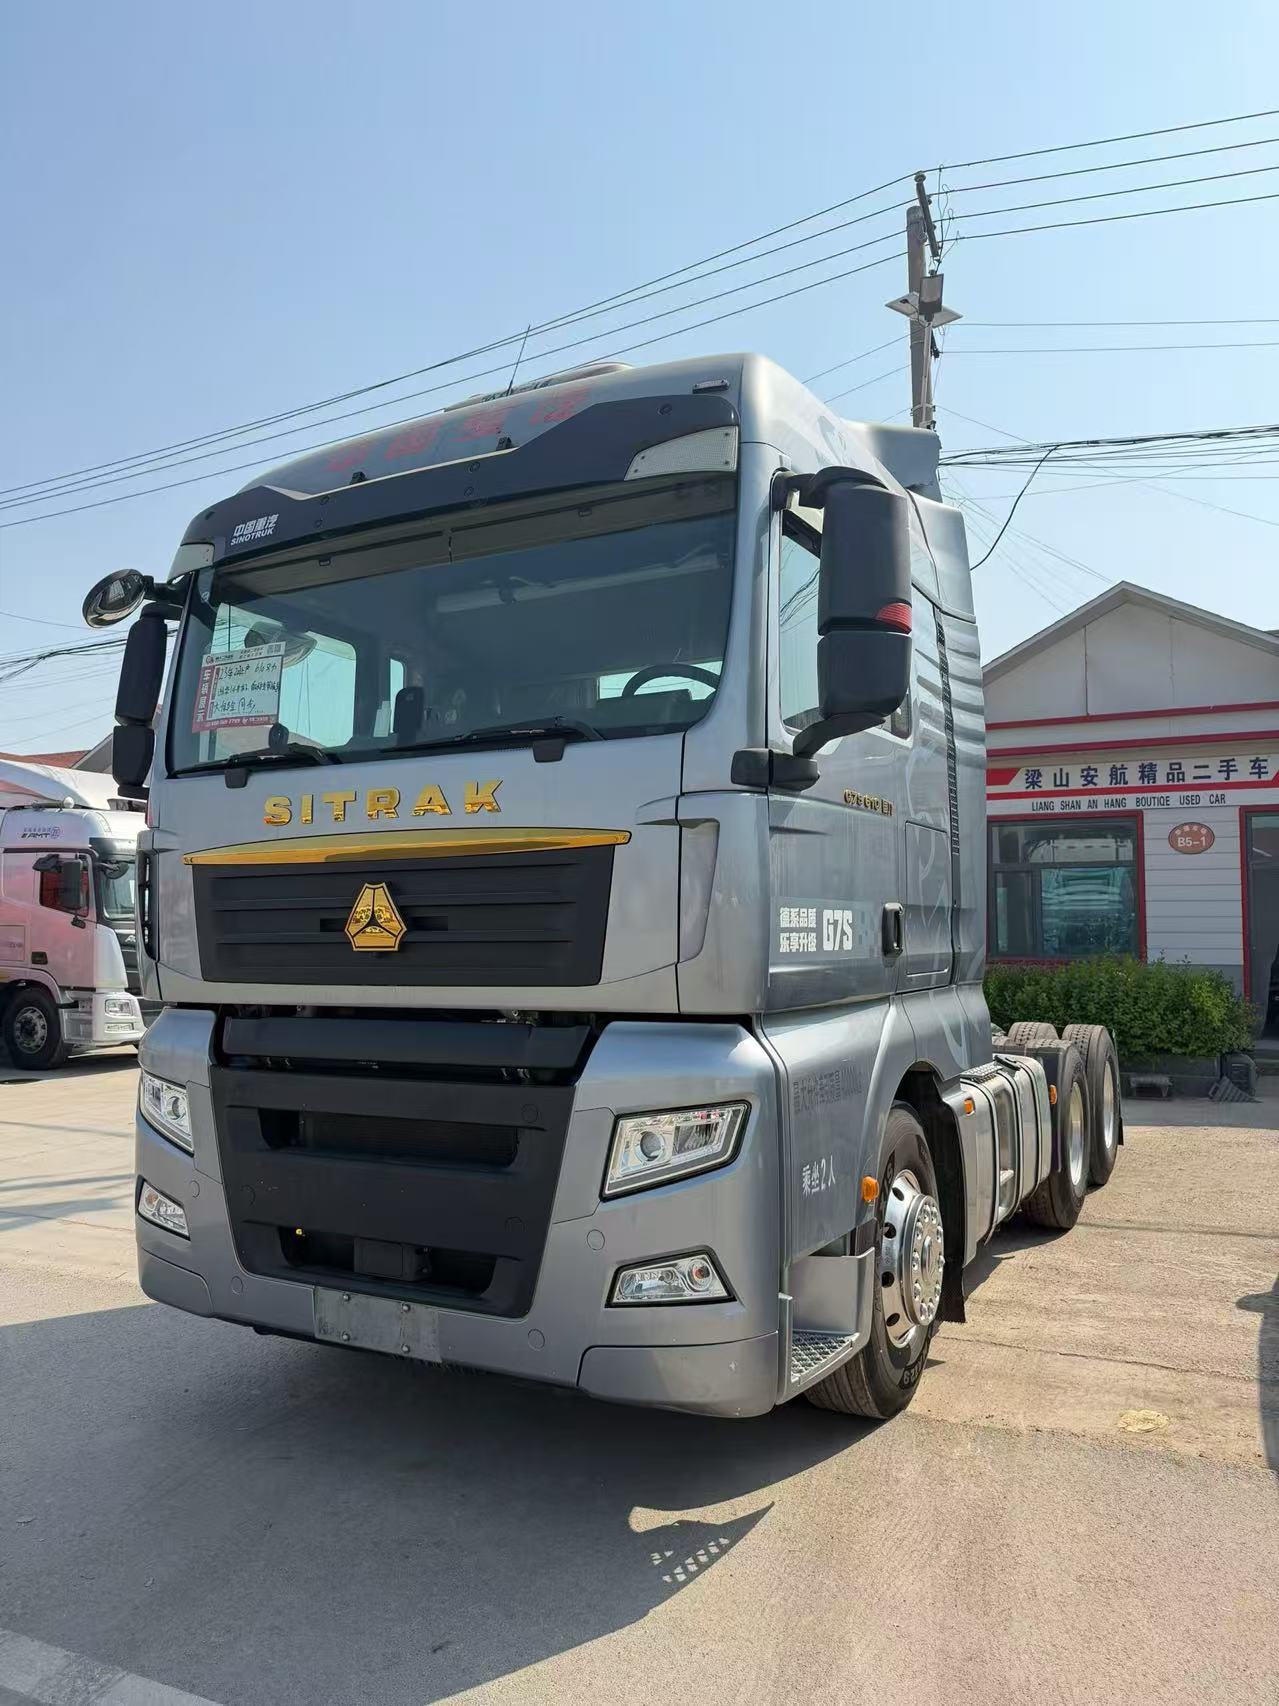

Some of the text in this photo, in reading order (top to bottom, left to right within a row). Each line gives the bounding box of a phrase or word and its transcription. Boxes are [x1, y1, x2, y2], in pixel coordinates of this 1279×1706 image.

[230, 527, 275, 546] SINOTRUK
[1024, 757, 1269, 790] 梁山安航精品二手车
[262, 779, 503, 826] SITRAK
[1031, 800, 1055, 812] LIANG
[1060, 799, 1082, 811] SHAN
[1087, 798, 1099, 810] AN
[1103, 797, 1127, 809] HANG
[1179, 794, 1201, 806] USED
[1208, 793, 1226, 804] CAR
[1177, 836, 1207, 847] B5-1
[822, 909, 853, 951] G7S
